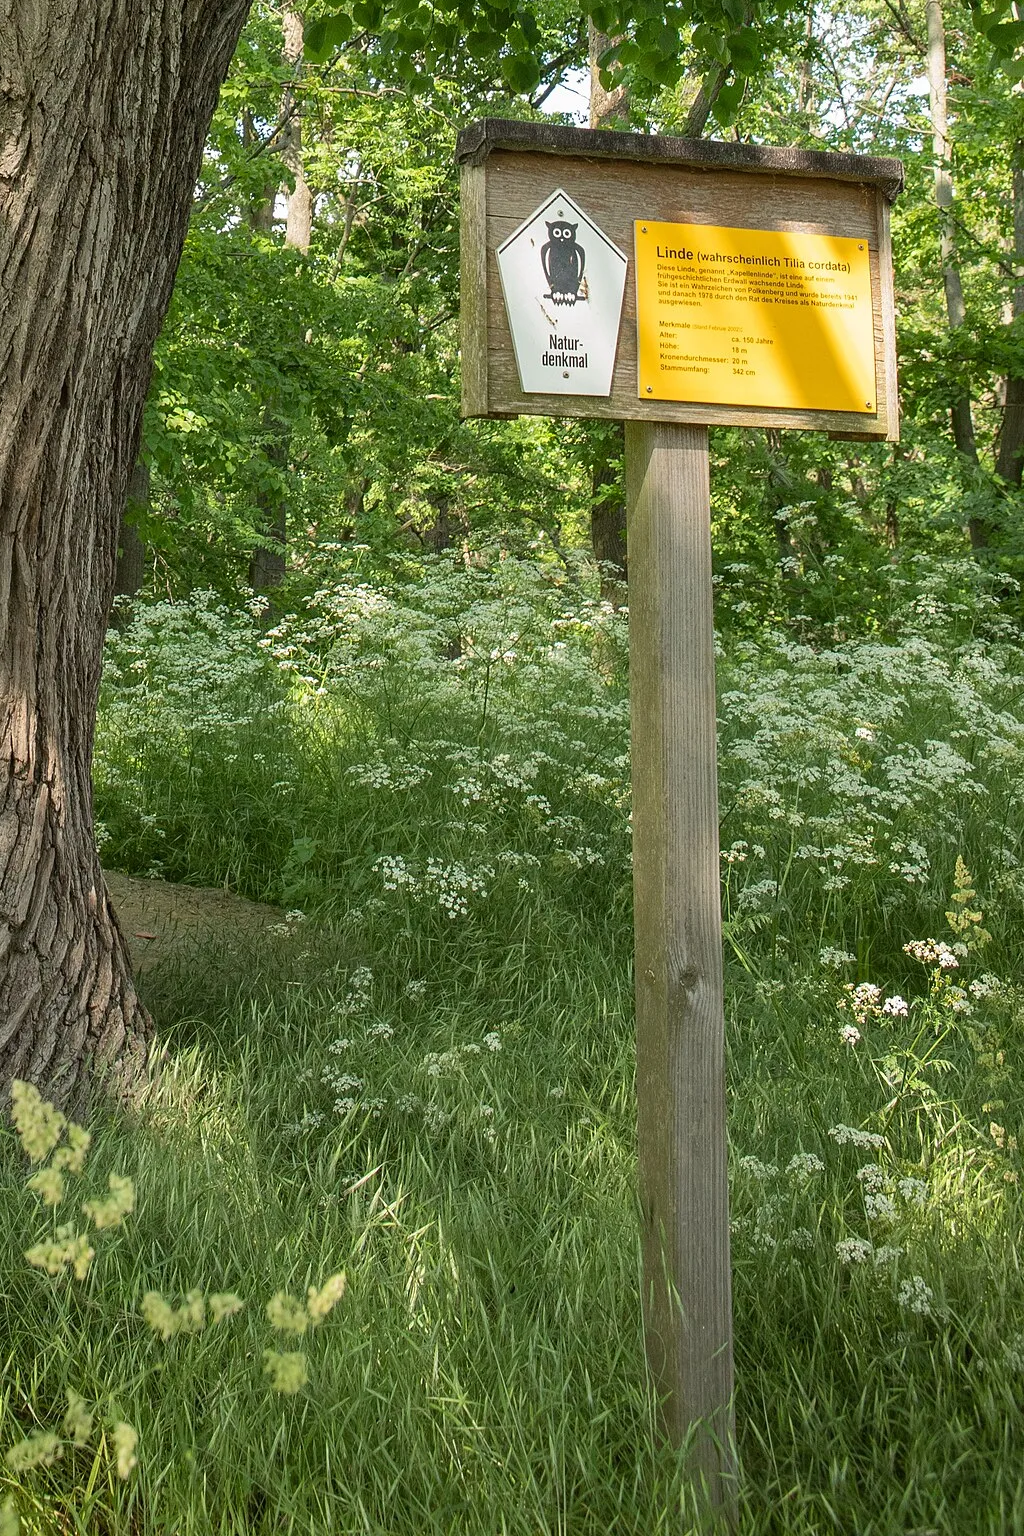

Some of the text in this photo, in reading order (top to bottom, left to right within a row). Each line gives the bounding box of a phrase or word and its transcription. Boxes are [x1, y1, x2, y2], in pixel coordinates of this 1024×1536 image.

[656, 246, 851, 274] Linde (wahrscheinlich Tilia cordata)
[677, 265, 697, 273] Linde,
[657, 272, 722, 283] frühgeschichtlichen
[723, 277, 748, 285] Erdwall
[749, 279, 785, 288] wachsende
[691, 283, 733, 292] Wahrzeichen
[799, 291, 819, 299] wurde
[820, 292, 842, 300] bereits
[672, 290, 697, 298] danach
[714, 293, 734, 301] durch
[761, 296, 773, 304] des
[774, 297, 799, 305] Kreises
[811, 300, 855, 309] Naturdenkmal
[659, 320, 691, 329] Merkmale
[549, 334, 584, 351] Natur-
[659, 331, 678, 339] Alter:
[755, 337, 774, 345] Jahre
[659, 342, 680, 350] Höhe:
[542, 350, 588, 368] denkmal
[659, 352, 729, 364] Kronendurchmesser:
[732, 357, 740, 365] 20
[660, 363, 711, 375] Stammumfang:
